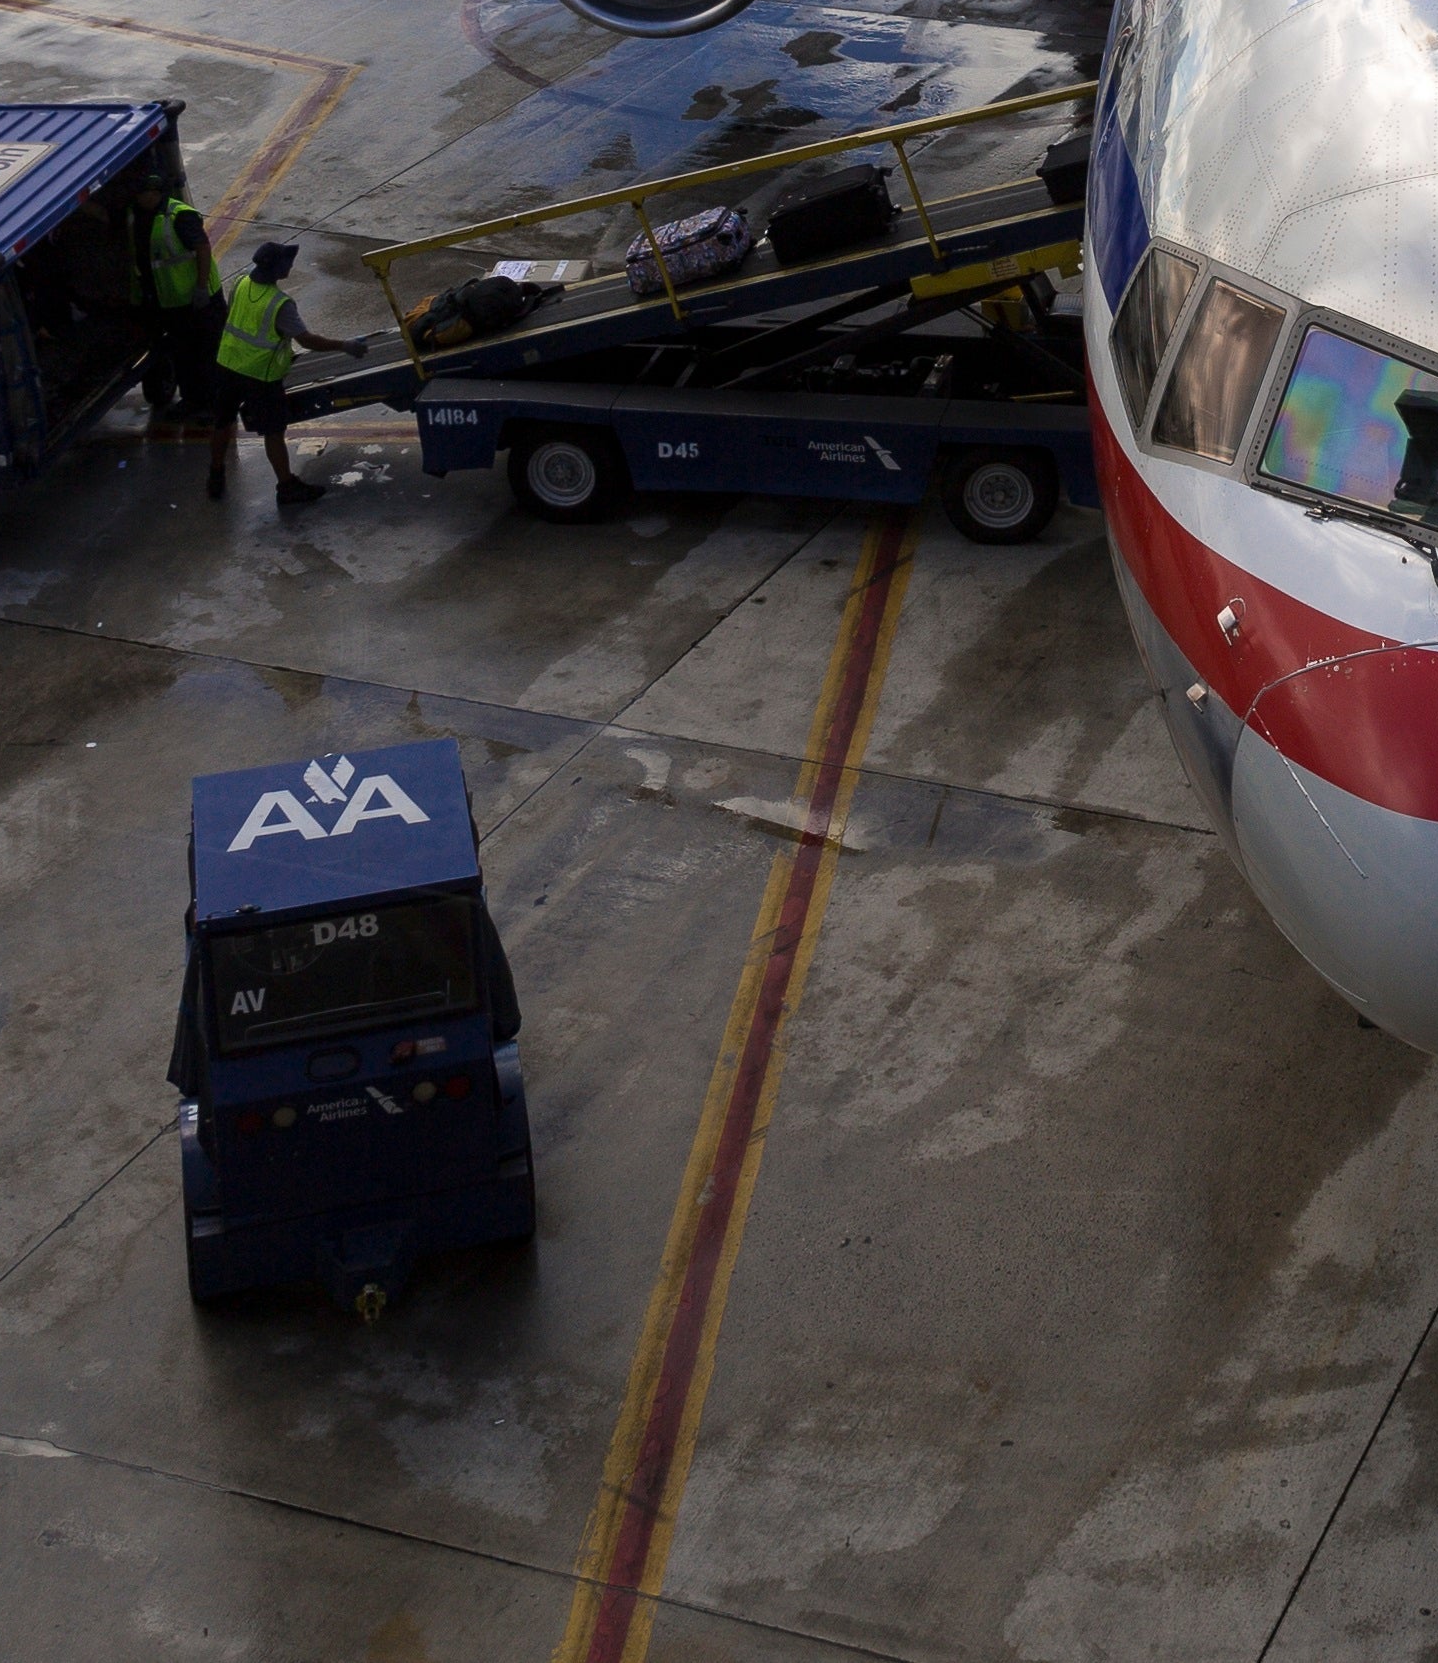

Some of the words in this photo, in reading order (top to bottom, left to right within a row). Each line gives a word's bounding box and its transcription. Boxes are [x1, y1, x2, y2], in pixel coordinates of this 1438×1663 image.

[426, 408, 479, 426] 14184
[657, 441, 700, 460] D45
[808, 440, 866, 453] American
[819, 451, 866, 464] Airlines
[226, 773, 430, 853] AA
[312, 913, 380, 947] D48
[230, 987, 266, 1016] AV
[319, 1106, 368, 1123] Airlines
